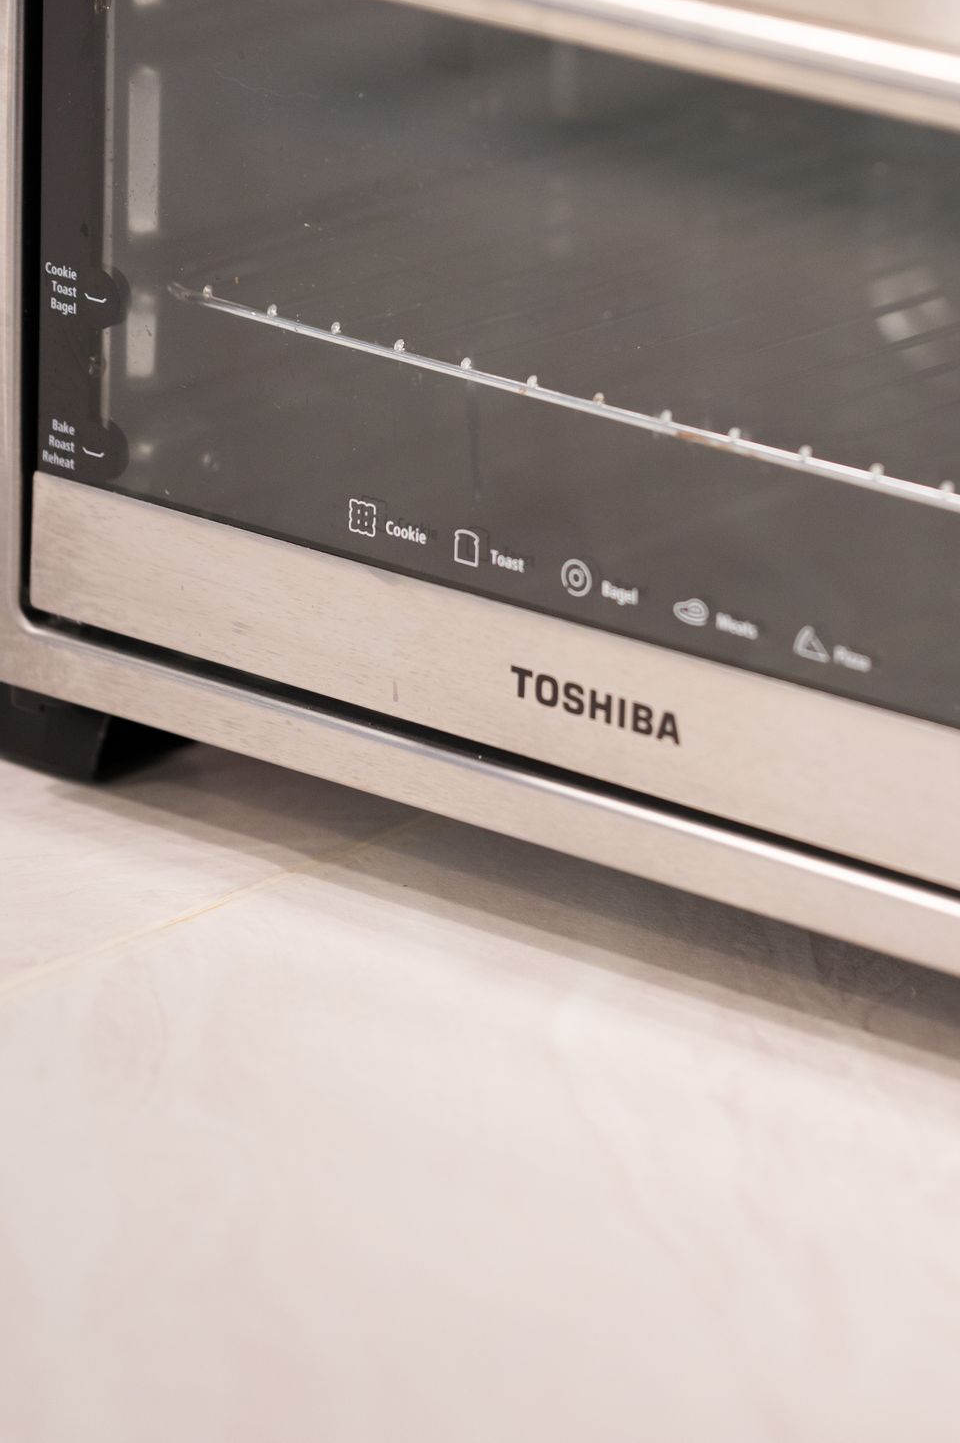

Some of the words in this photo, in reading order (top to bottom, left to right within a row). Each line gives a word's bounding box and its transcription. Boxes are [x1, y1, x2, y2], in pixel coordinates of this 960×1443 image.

[45, 262, 77, 280] Cookie
[51, 280, 77, 297] Toast
[50, 298, 77, 315] Bagel
[52, 418, 75, 435] Bake
[48, 434, 75, 453] Roast
[42, 449, 75, 470] Reheat
[385, 520, 427, 545] Cookie
[490, 548, 525, 573] Toast
[510, 665, 680, 746] TOSHIBA
